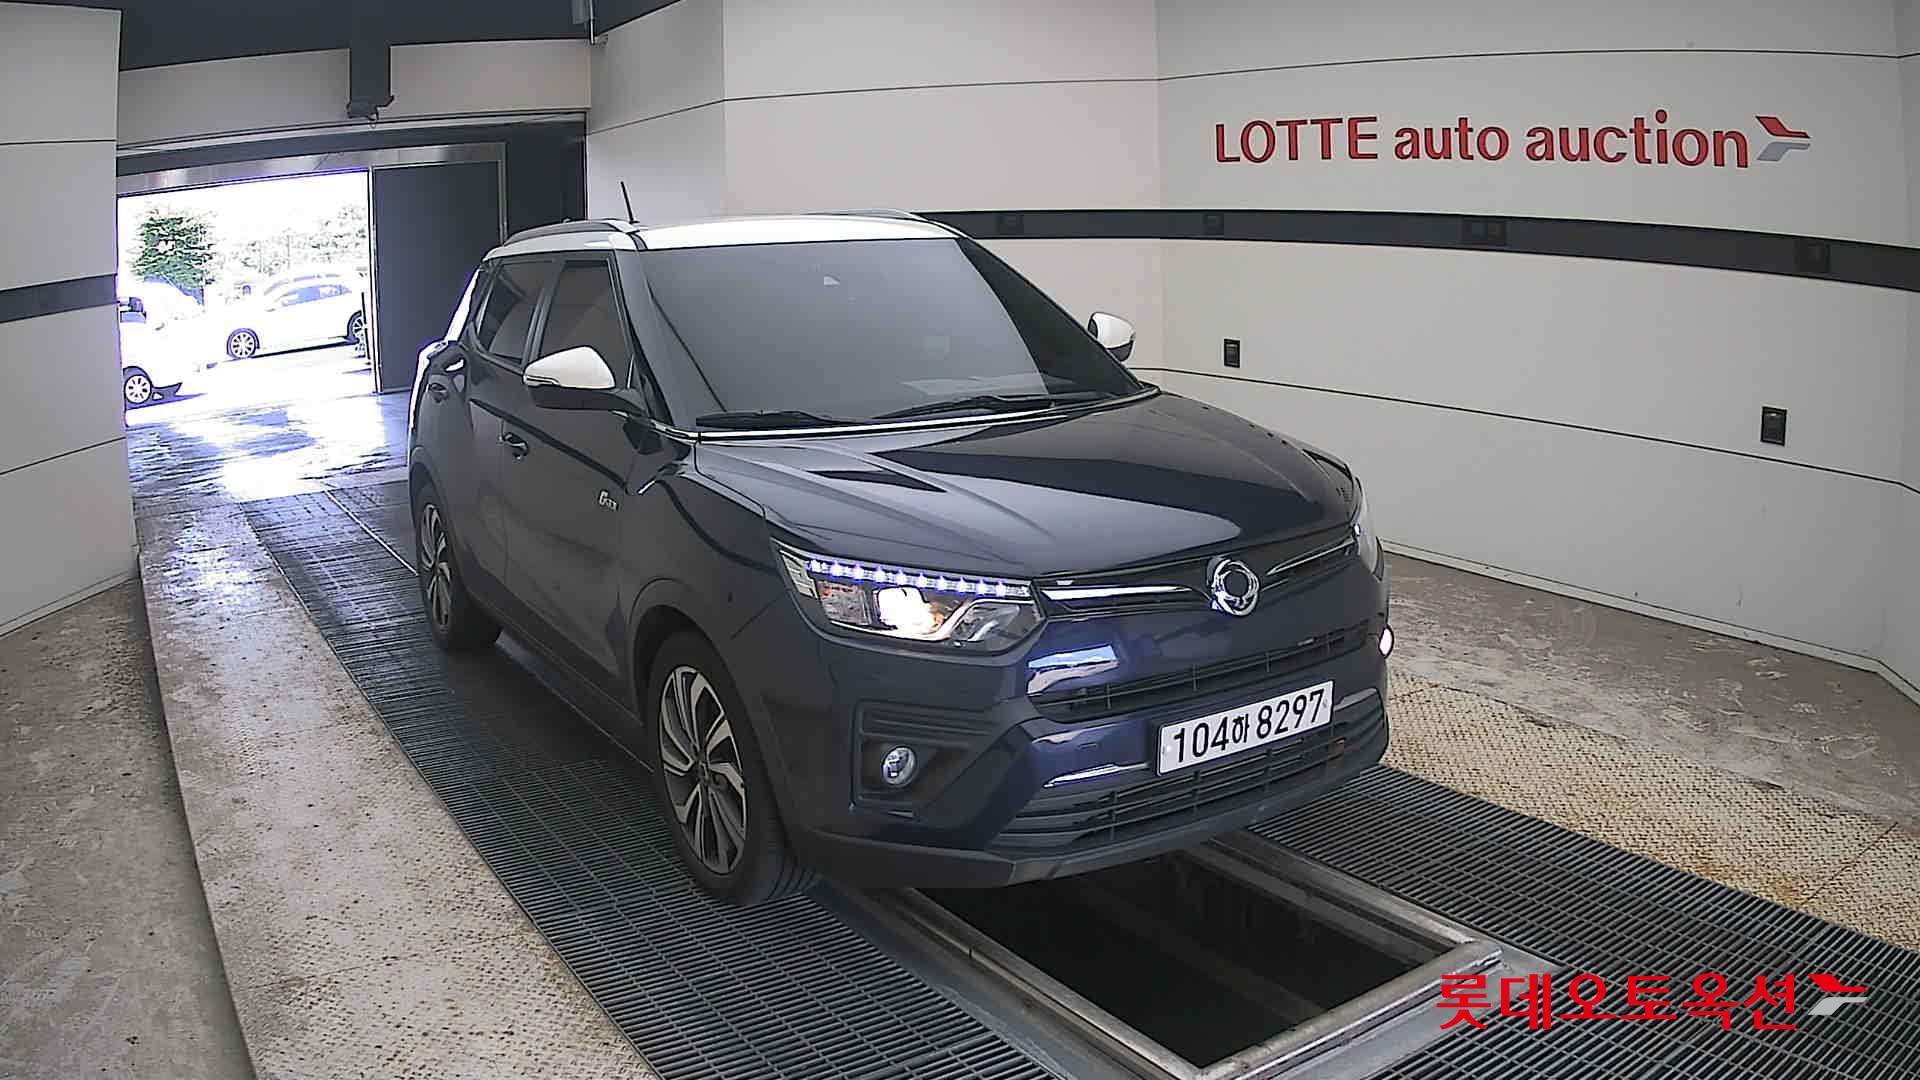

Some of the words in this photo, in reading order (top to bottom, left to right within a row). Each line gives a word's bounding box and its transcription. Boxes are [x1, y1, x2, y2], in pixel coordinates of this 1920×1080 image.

[1216, 117, 1378, 162] LOTTE
[1395, 117, 1510, 160] auto
[1526, 110, 1749, 168] auction
[1173, 714, 1250, 763] 104하
[1257, 688, 1325, 740] 8297
